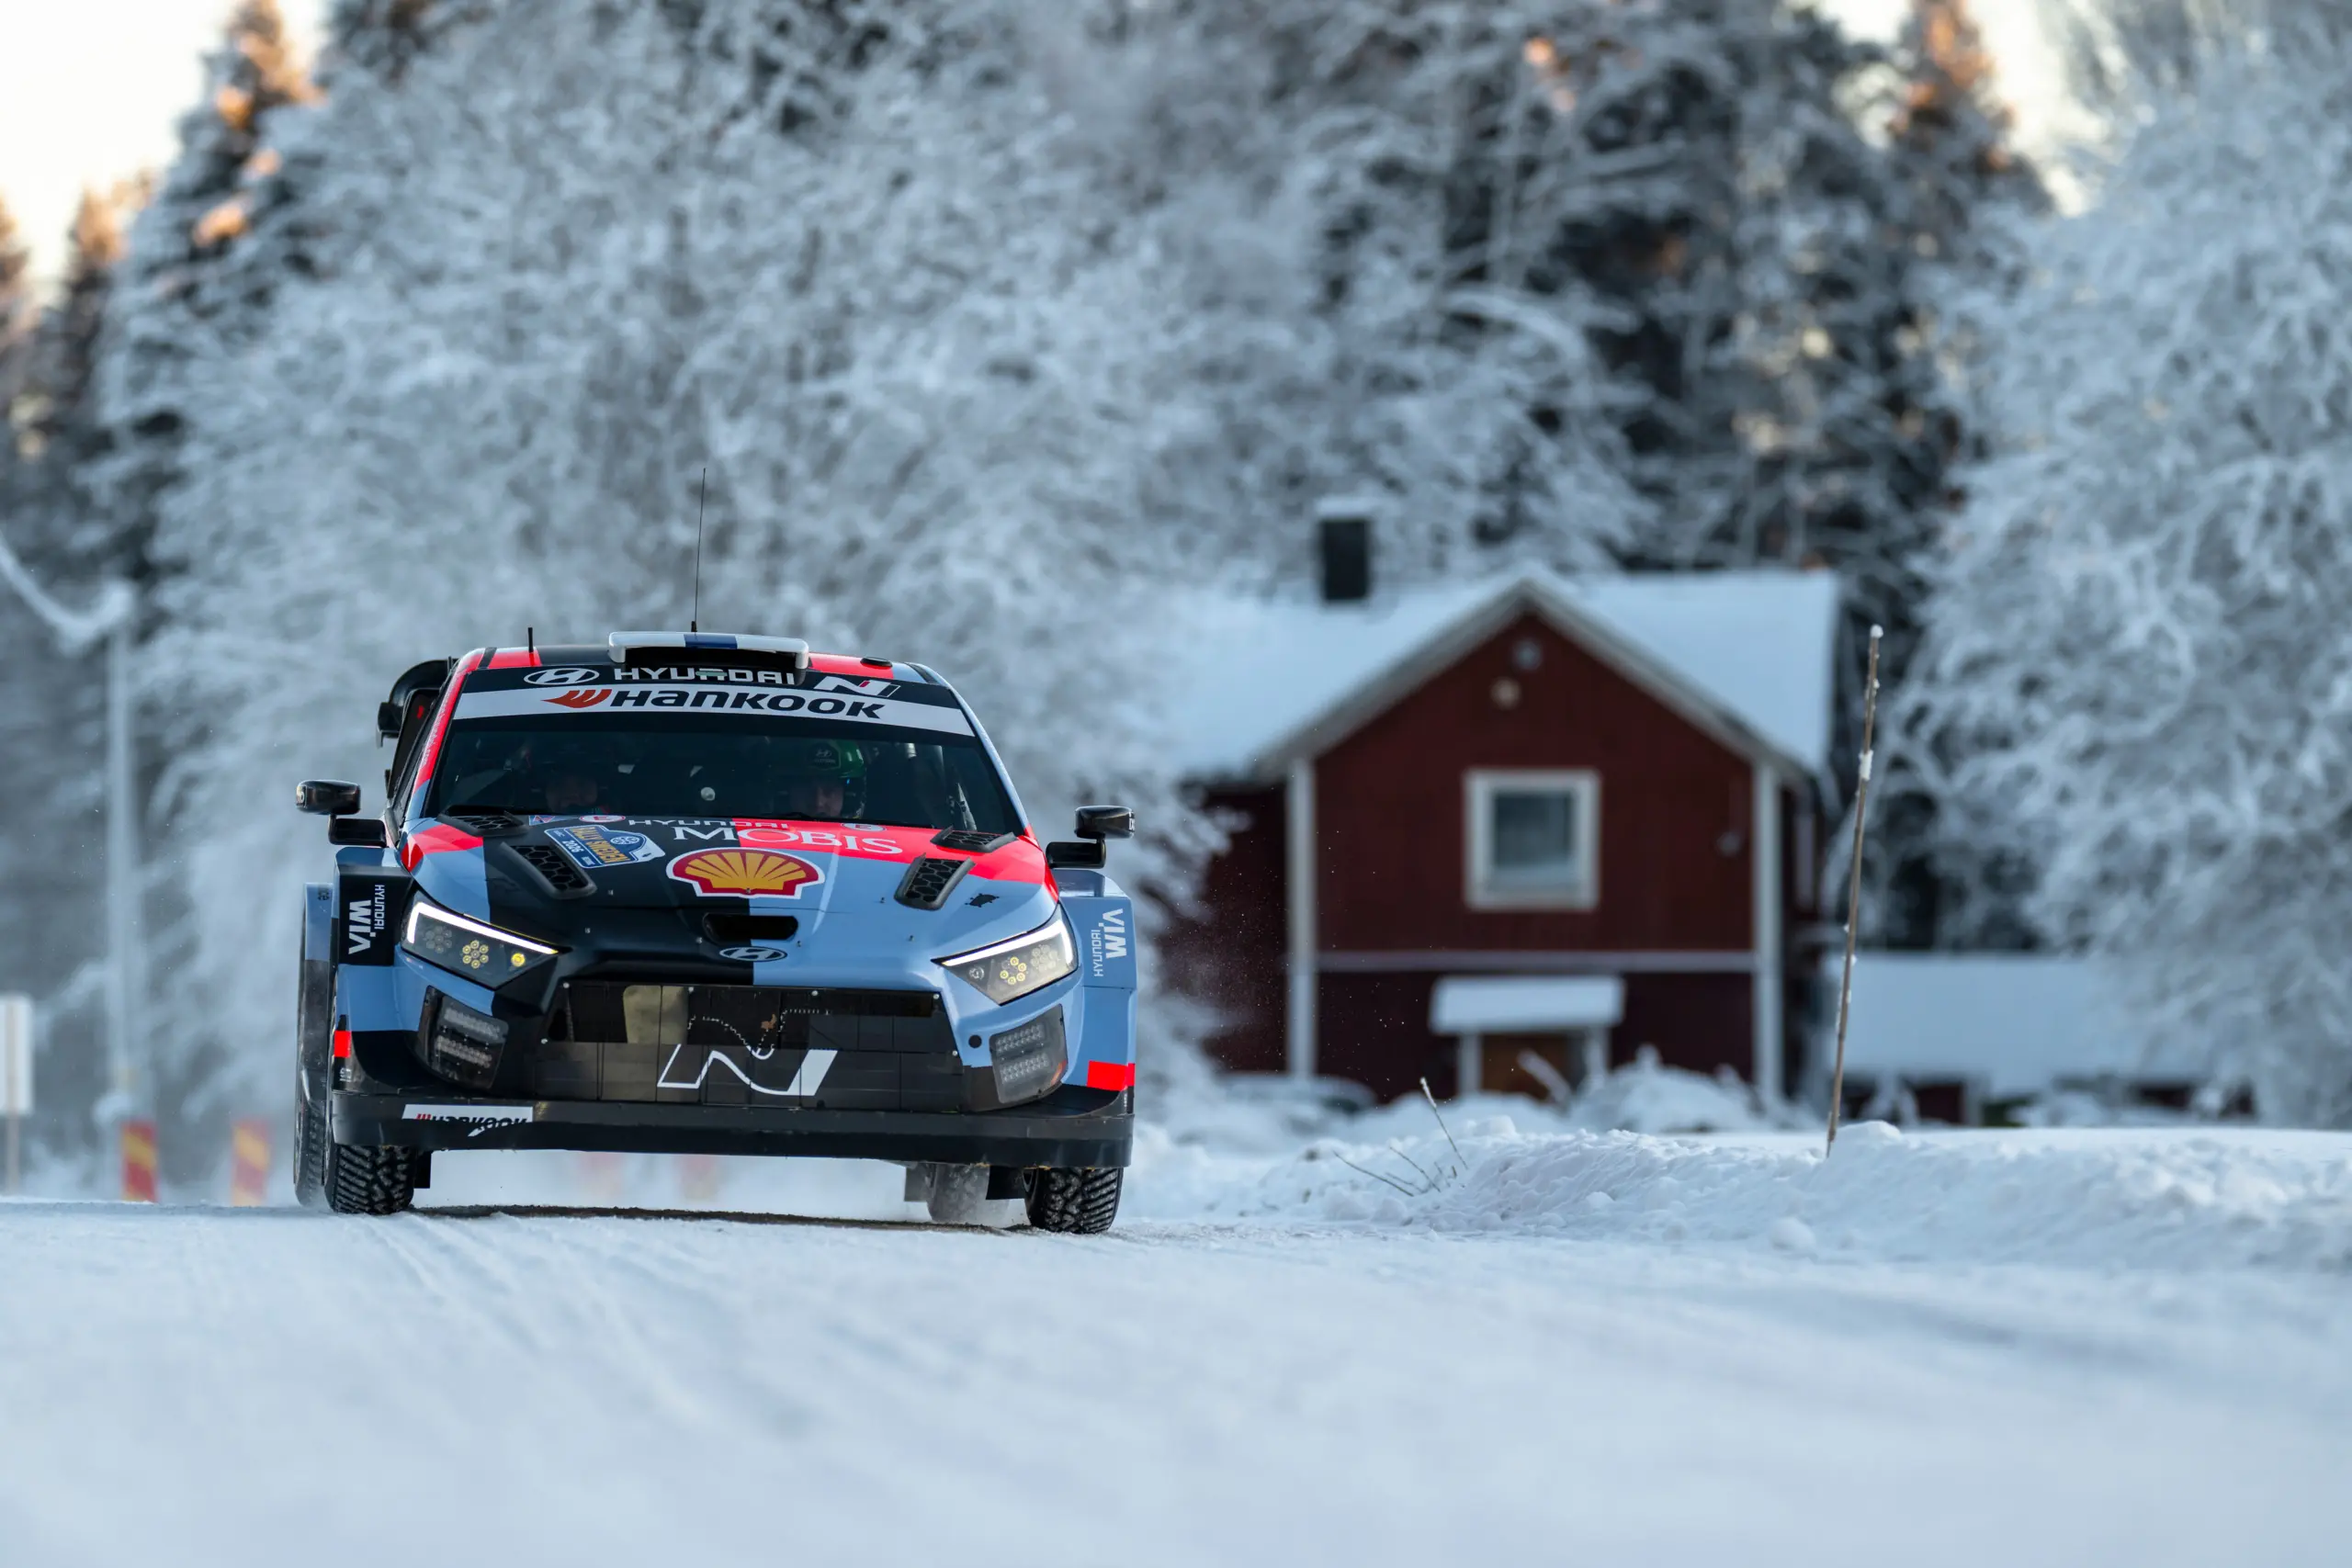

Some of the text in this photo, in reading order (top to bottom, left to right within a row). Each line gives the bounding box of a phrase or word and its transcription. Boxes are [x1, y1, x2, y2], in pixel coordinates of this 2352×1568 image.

[615, 668, 795, 685] HYUNDAI
[628, 819, 787, 829] HYUNDAI
[672, 827, 903, 854] MOBIS
[561, 840, 584, 853] 2026
[374, 885, 385, 930] HYUNDAI
[348, 900, 376, 954] WIA
[1098, 908, 1127, 959] WIA
[1091, 930, 1104, 976] HYUNDAI
